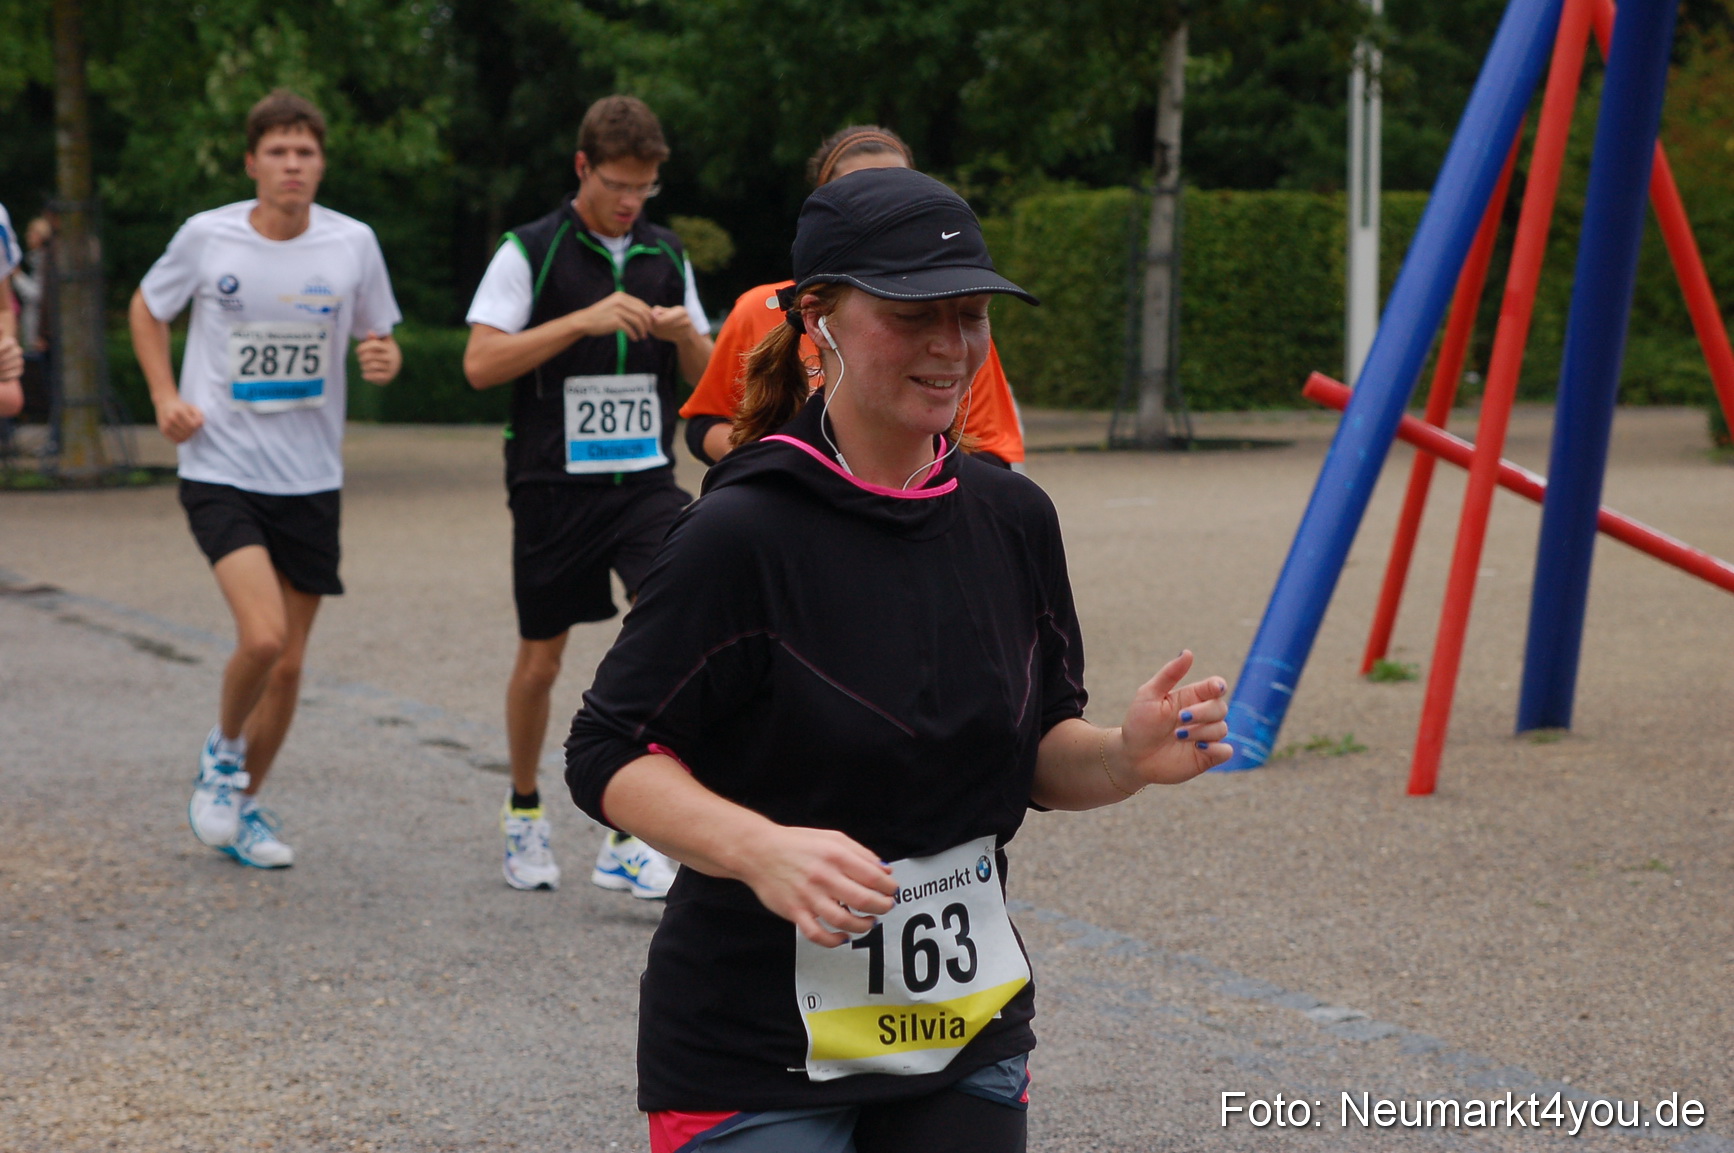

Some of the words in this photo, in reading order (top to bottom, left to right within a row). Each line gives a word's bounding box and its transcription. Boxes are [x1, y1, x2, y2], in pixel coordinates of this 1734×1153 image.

[240, 344, 320, 376] 2875
[578, 398, 652, 434] 2876
[852, 902, 978, 995] 163
[878, 1011, 966, 1046] Silvia
